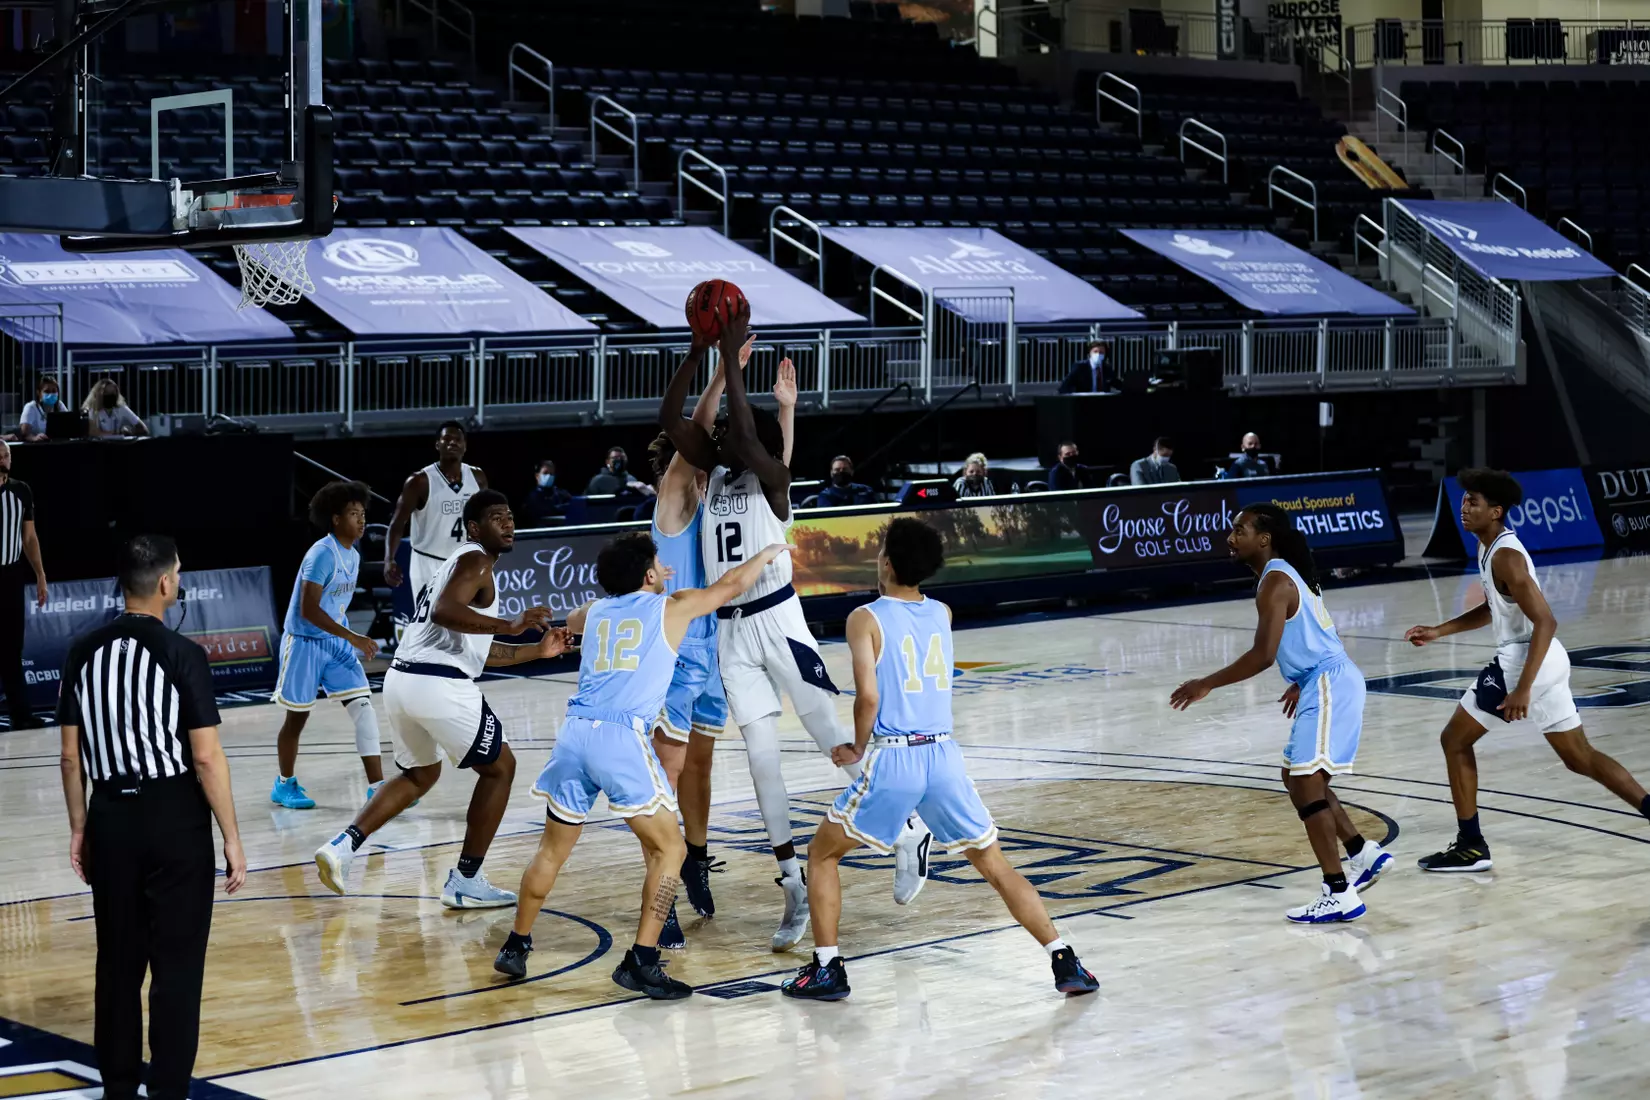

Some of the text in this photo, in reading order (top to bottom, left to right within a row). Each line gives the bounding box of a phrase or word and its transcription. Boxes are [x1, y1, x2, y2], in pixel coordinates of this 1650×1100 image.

[1268, 0, 1340, 17] PURPOSE
[24, 264, 174, 279] provider
[909, 254, 1035, 274] Altura
[442, 499, 468, 515] CB
[709, 493, 748, 516] CBU
[1302, 496, 1343, 512] Sponsor
[1344, 493, 1356, 506] of
[1506, 487, 1583, 536] pepsi
[451, 517, 463, 542] 4
[1099, 499, 1234, 554] Goose Creek
[1296, 510, 1384, 536] ATHLETICS
[715, 522, 743, 562] 12
[1134, 535, 1212, 558] GOLF CLUB
[496, 546, 598, 593] ose Cre
[30, 595, 97, 615] Fueled
[203, 636, 258, 655] vider
[594, 617, 643, 672] 12
[902, 633, 949, 693] 14
[35, 669, 61, 681] CBU
[477, 713, 496, 756] LANCERS
